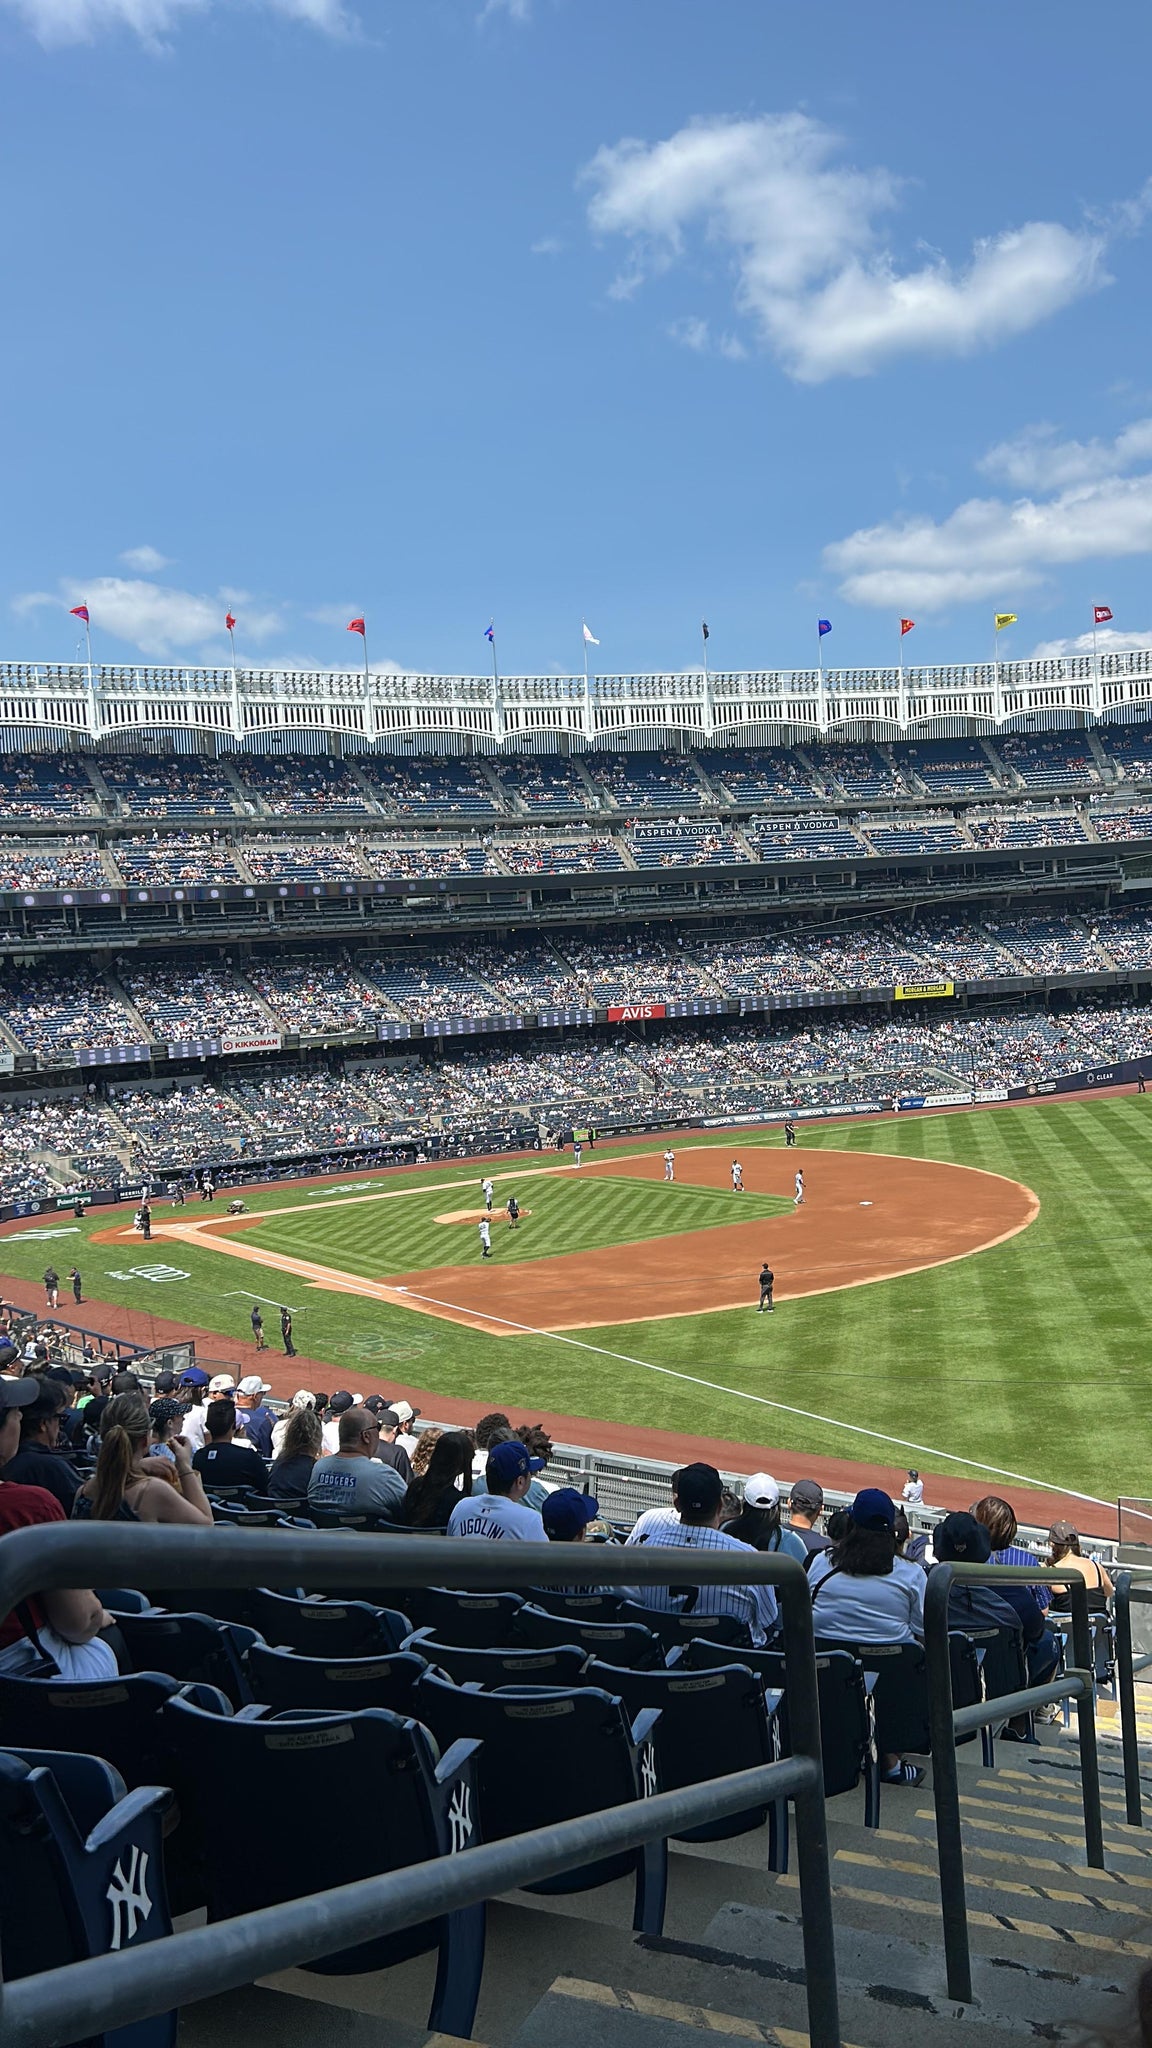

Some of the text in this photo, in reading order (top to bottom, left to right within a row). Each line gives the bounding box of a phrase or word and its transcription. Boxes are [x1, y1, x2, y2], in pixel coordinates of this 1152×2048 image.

[639, 826, 718, 837] ASPEN VODKA
[759, 821, 835, 832] ASPEN VODKA
[621, 1006, 652, 1019] AVIS
[235, 1038, 278, 1049] KIKKOMAN
[1096, 1073, 1114, 1081] CLEAR
[320, 1474, 354, 1487] DODGERS
[460, 1517, 505, 1539] UGOLINI
